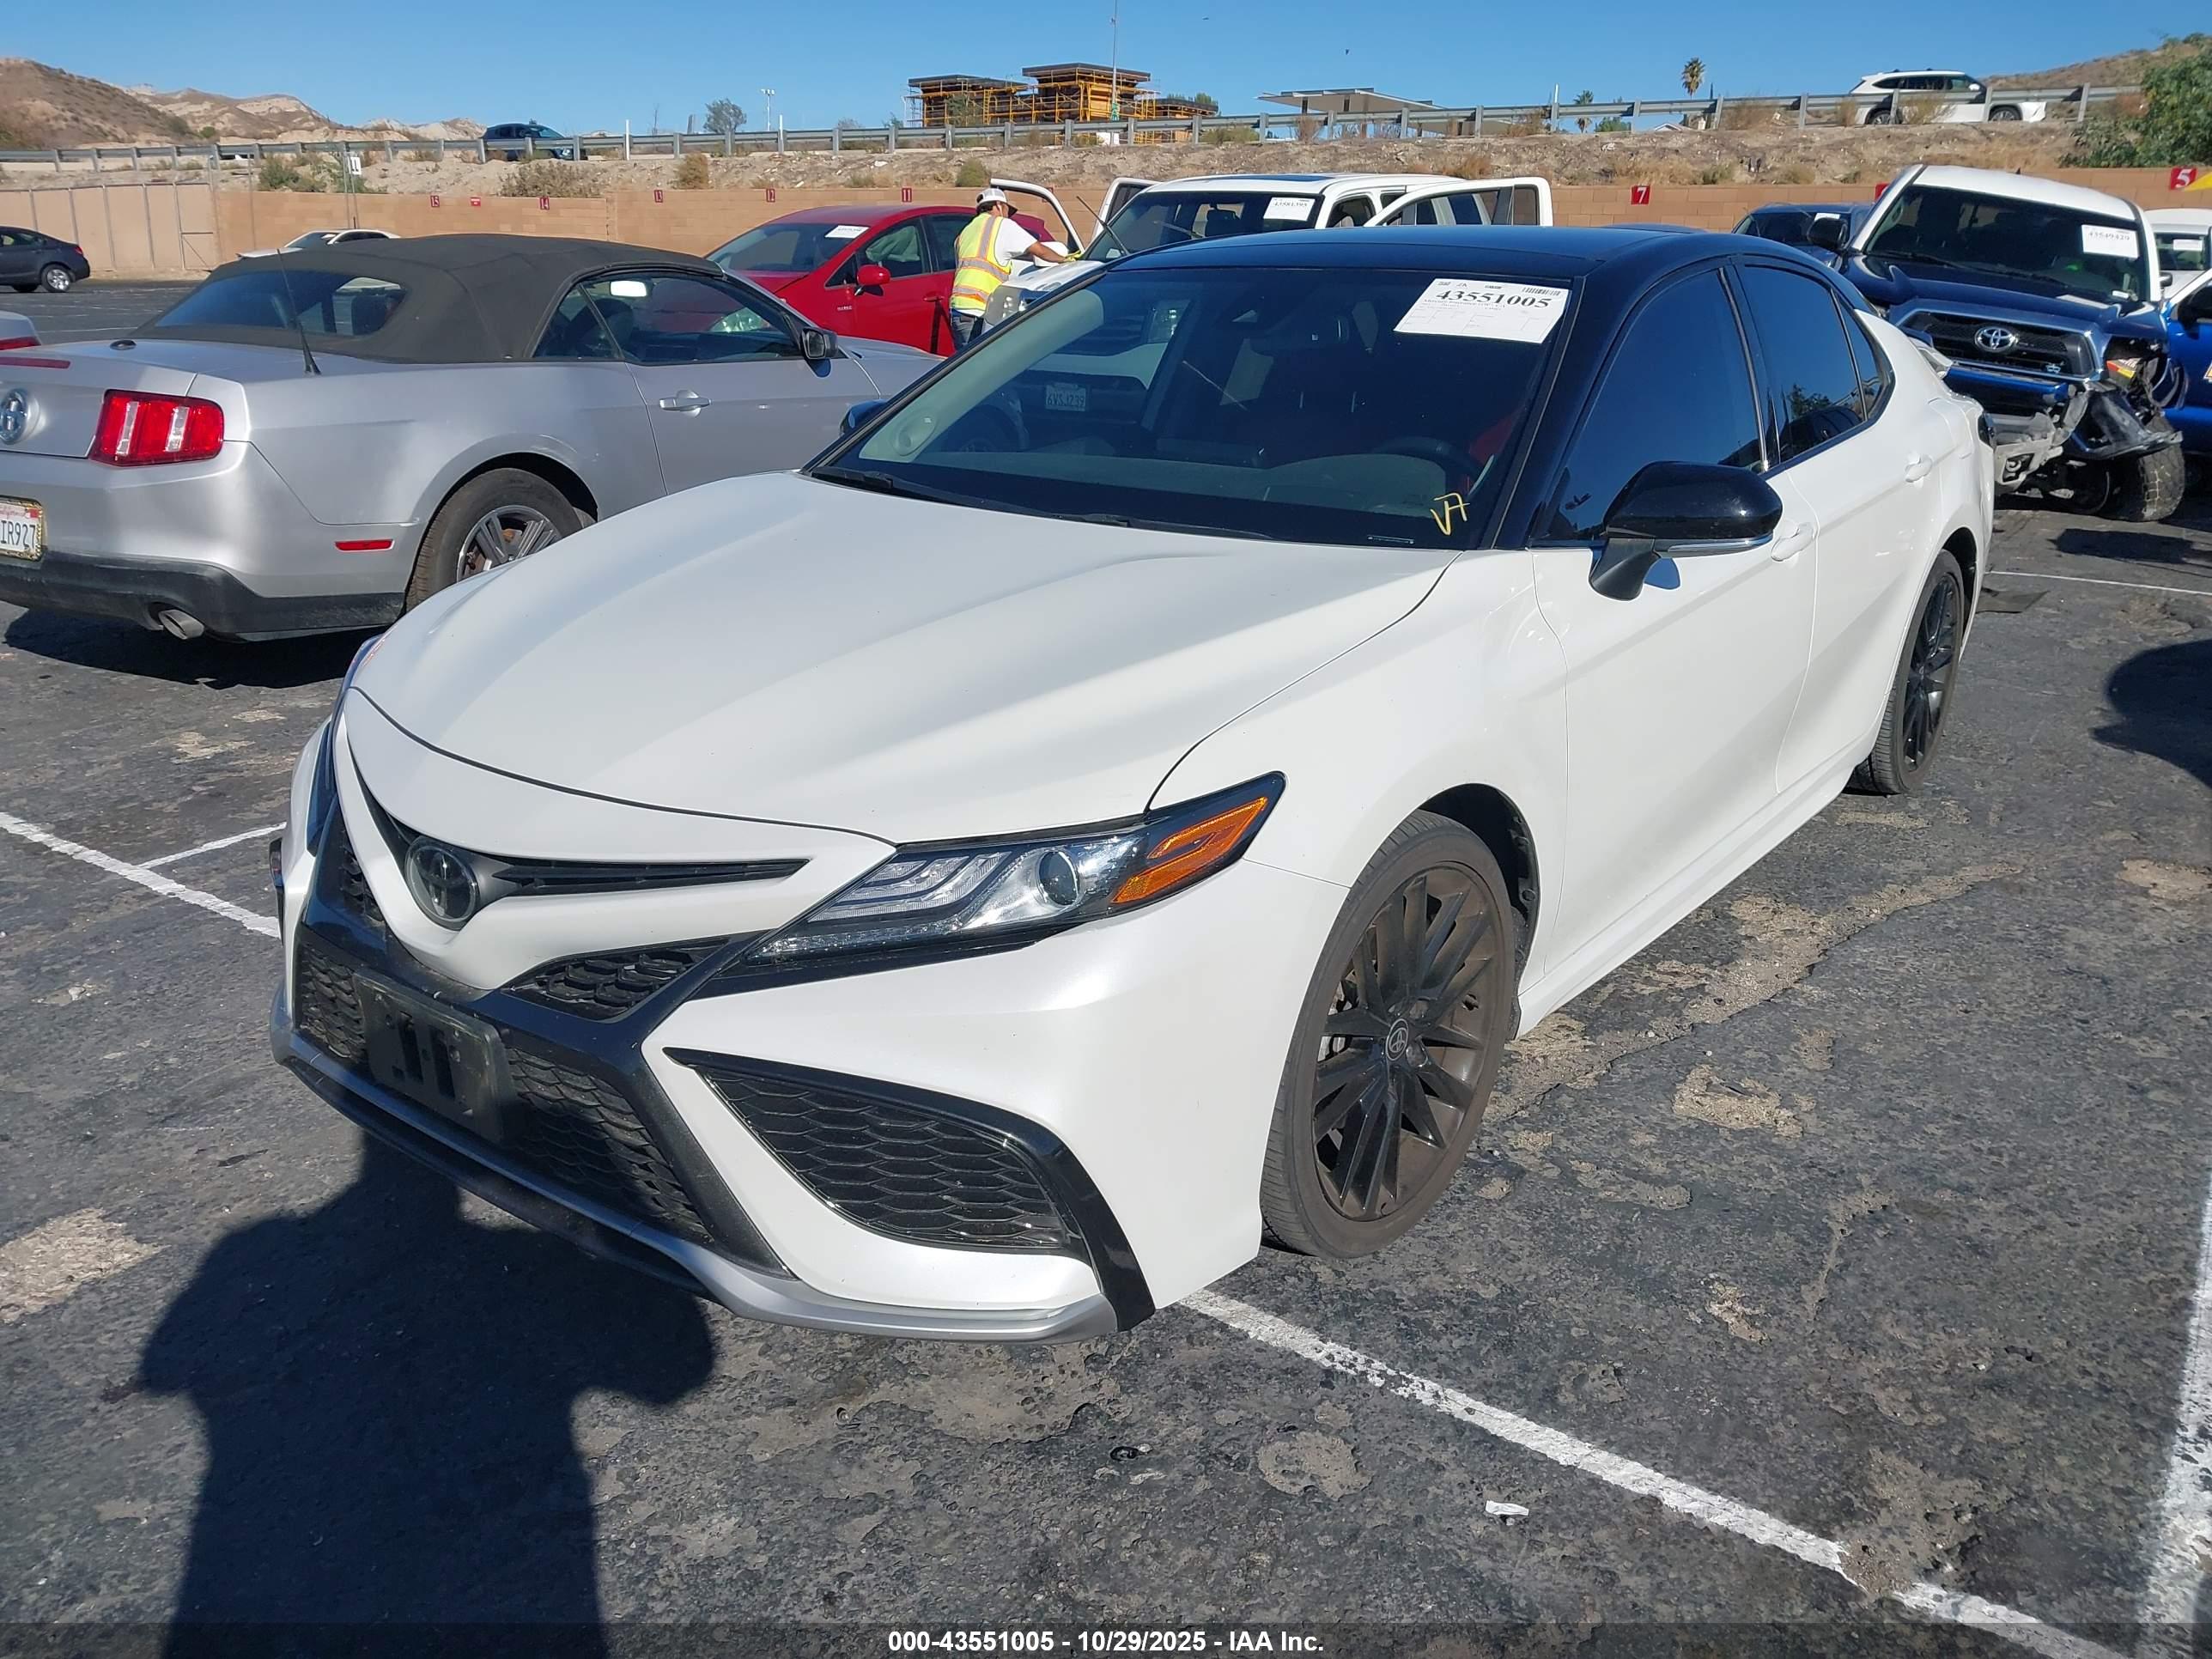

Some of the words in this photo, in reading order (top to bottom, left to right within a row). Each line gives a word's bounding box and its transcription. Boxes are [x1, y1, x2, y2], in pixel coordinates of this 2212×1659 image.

[2175, 168, 2191, 188] 5
[902, 189, 911, 202] 11
[1637, 186, 1647, 204] 7
[1436, 290, 1553, 308] 43551005
[1, 520, 36, 550] IR927
